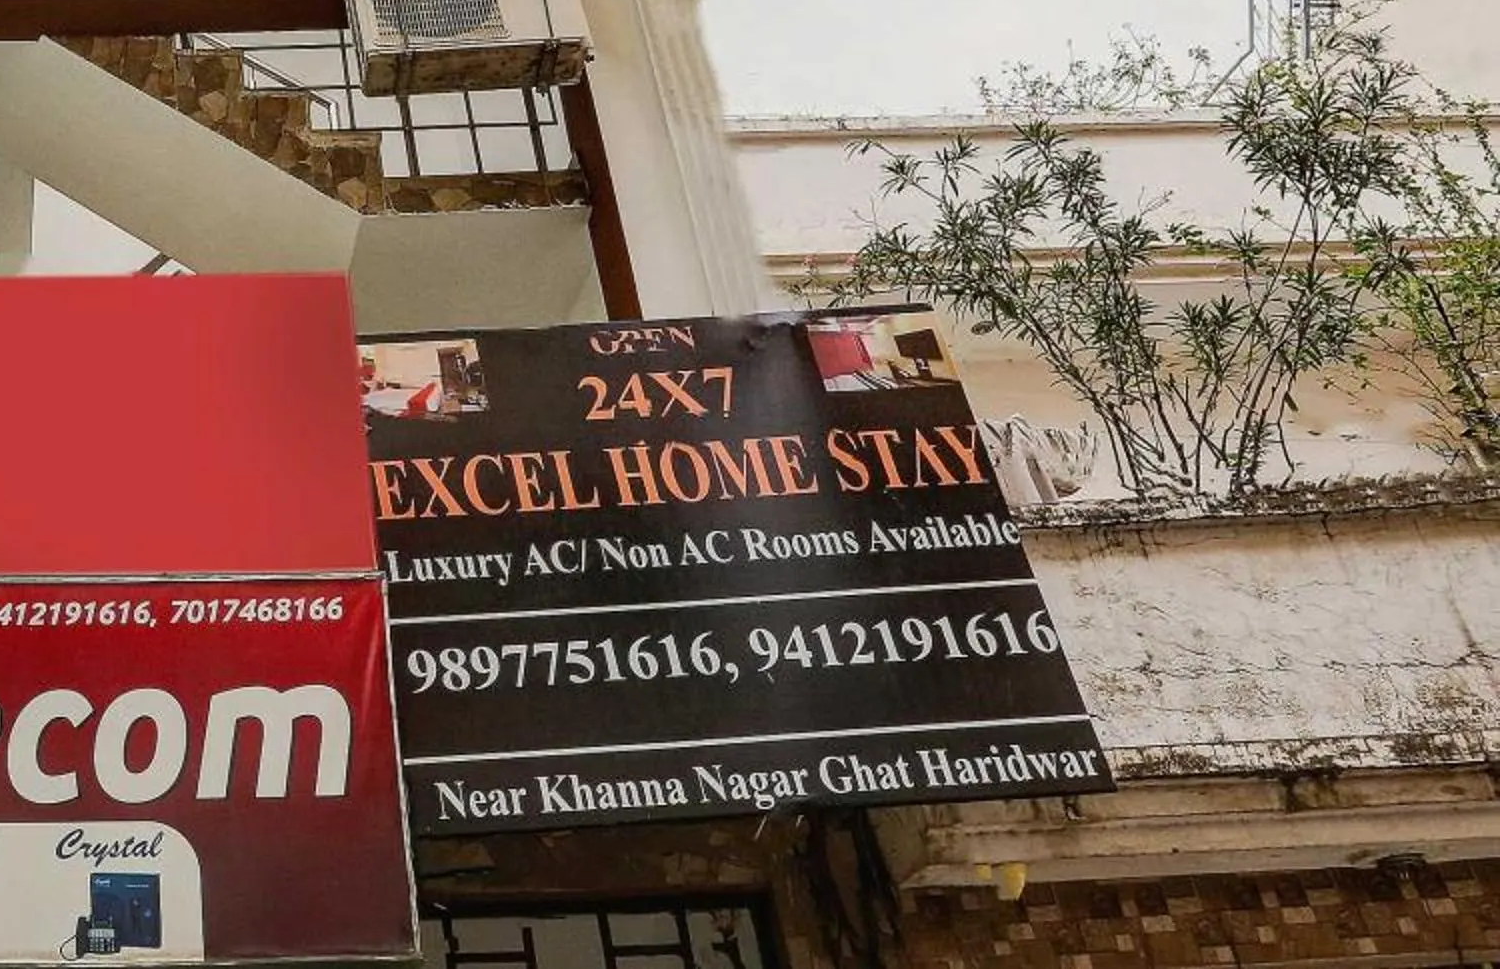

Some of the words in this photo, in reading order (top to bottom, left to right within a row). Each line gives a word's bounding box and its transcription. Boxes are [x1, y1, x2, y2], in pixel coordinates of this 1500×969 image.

[577, 366, 733, 421] 24X7
[369, 450, 599, 520] EXCEL
[603, 439, 817, 506] HOME
[823, 424, 991, 492] STAY
[384, 549, 513, 585] Luxury
[524, 540, 589, 576] AC/
[596, 537, 669, 571] Non
[679, 531, 735, 564] AC
[741, 525, 860, 561] Rooms
[869, 513, 1021, 553] Available
[170, 597, 344, 623] 7017468166
[406, 630, 740, 694] 9897751616,
[748, 609, 1060, 670] 9412191616
[433, 780, 528, 822] Near
[535, 772, 689, 815] Khanna
[692, 762, 810, 809] Nagar
[818, 753, 916, 795] Ghat
[919, 743, 1101, 791] Haridwar
[55, 828, 164, 867] Crystal
